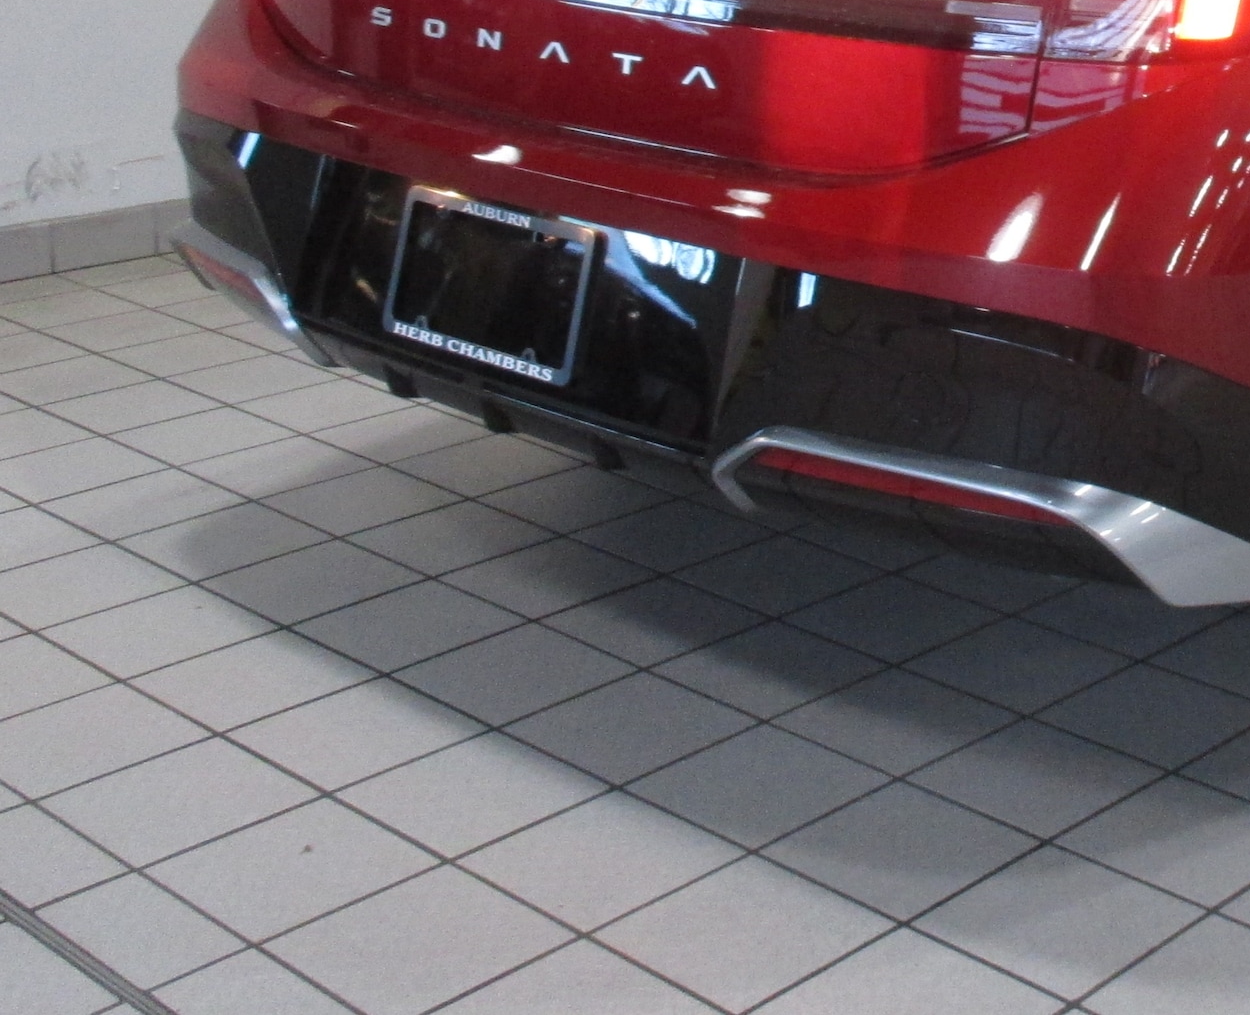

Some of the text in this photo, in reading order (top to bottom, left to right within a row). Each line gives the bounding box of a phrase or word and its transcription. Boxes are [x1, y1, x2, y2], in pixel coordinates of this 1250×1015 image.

[370, 7, 716, 89] SONATA
[463, 202, 531, 229] AUBURN
[393, 322, 553, 382] HERB CHAMBERS
